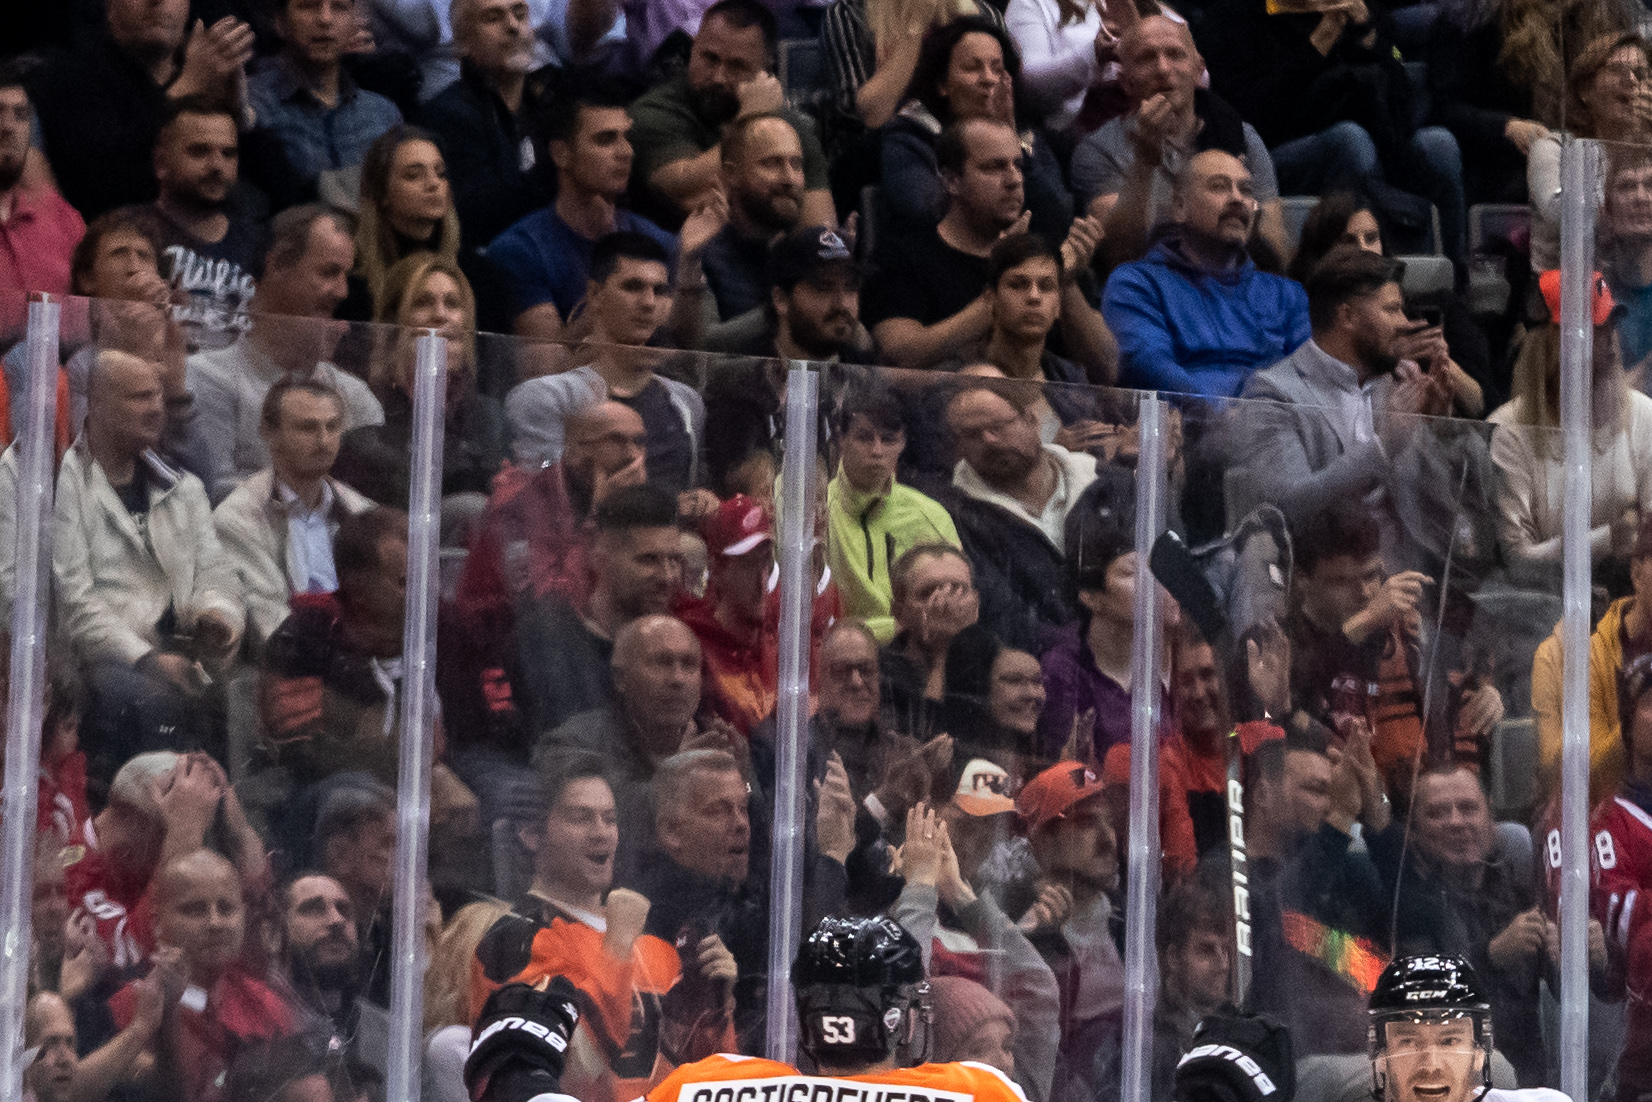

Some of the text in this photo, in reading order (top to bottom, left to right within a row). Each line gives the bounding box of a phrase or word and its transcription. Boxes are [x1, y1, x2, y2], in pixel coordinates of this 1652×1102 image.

[1413, 957, 1440, 971] 12
[1406, 989, 1448, 1000] CCM
[470, 1016, 567, 1053] BAU
[822, 1016, 855, 1044] 53
[1177, 1044, 1276, 1096] BAUE
